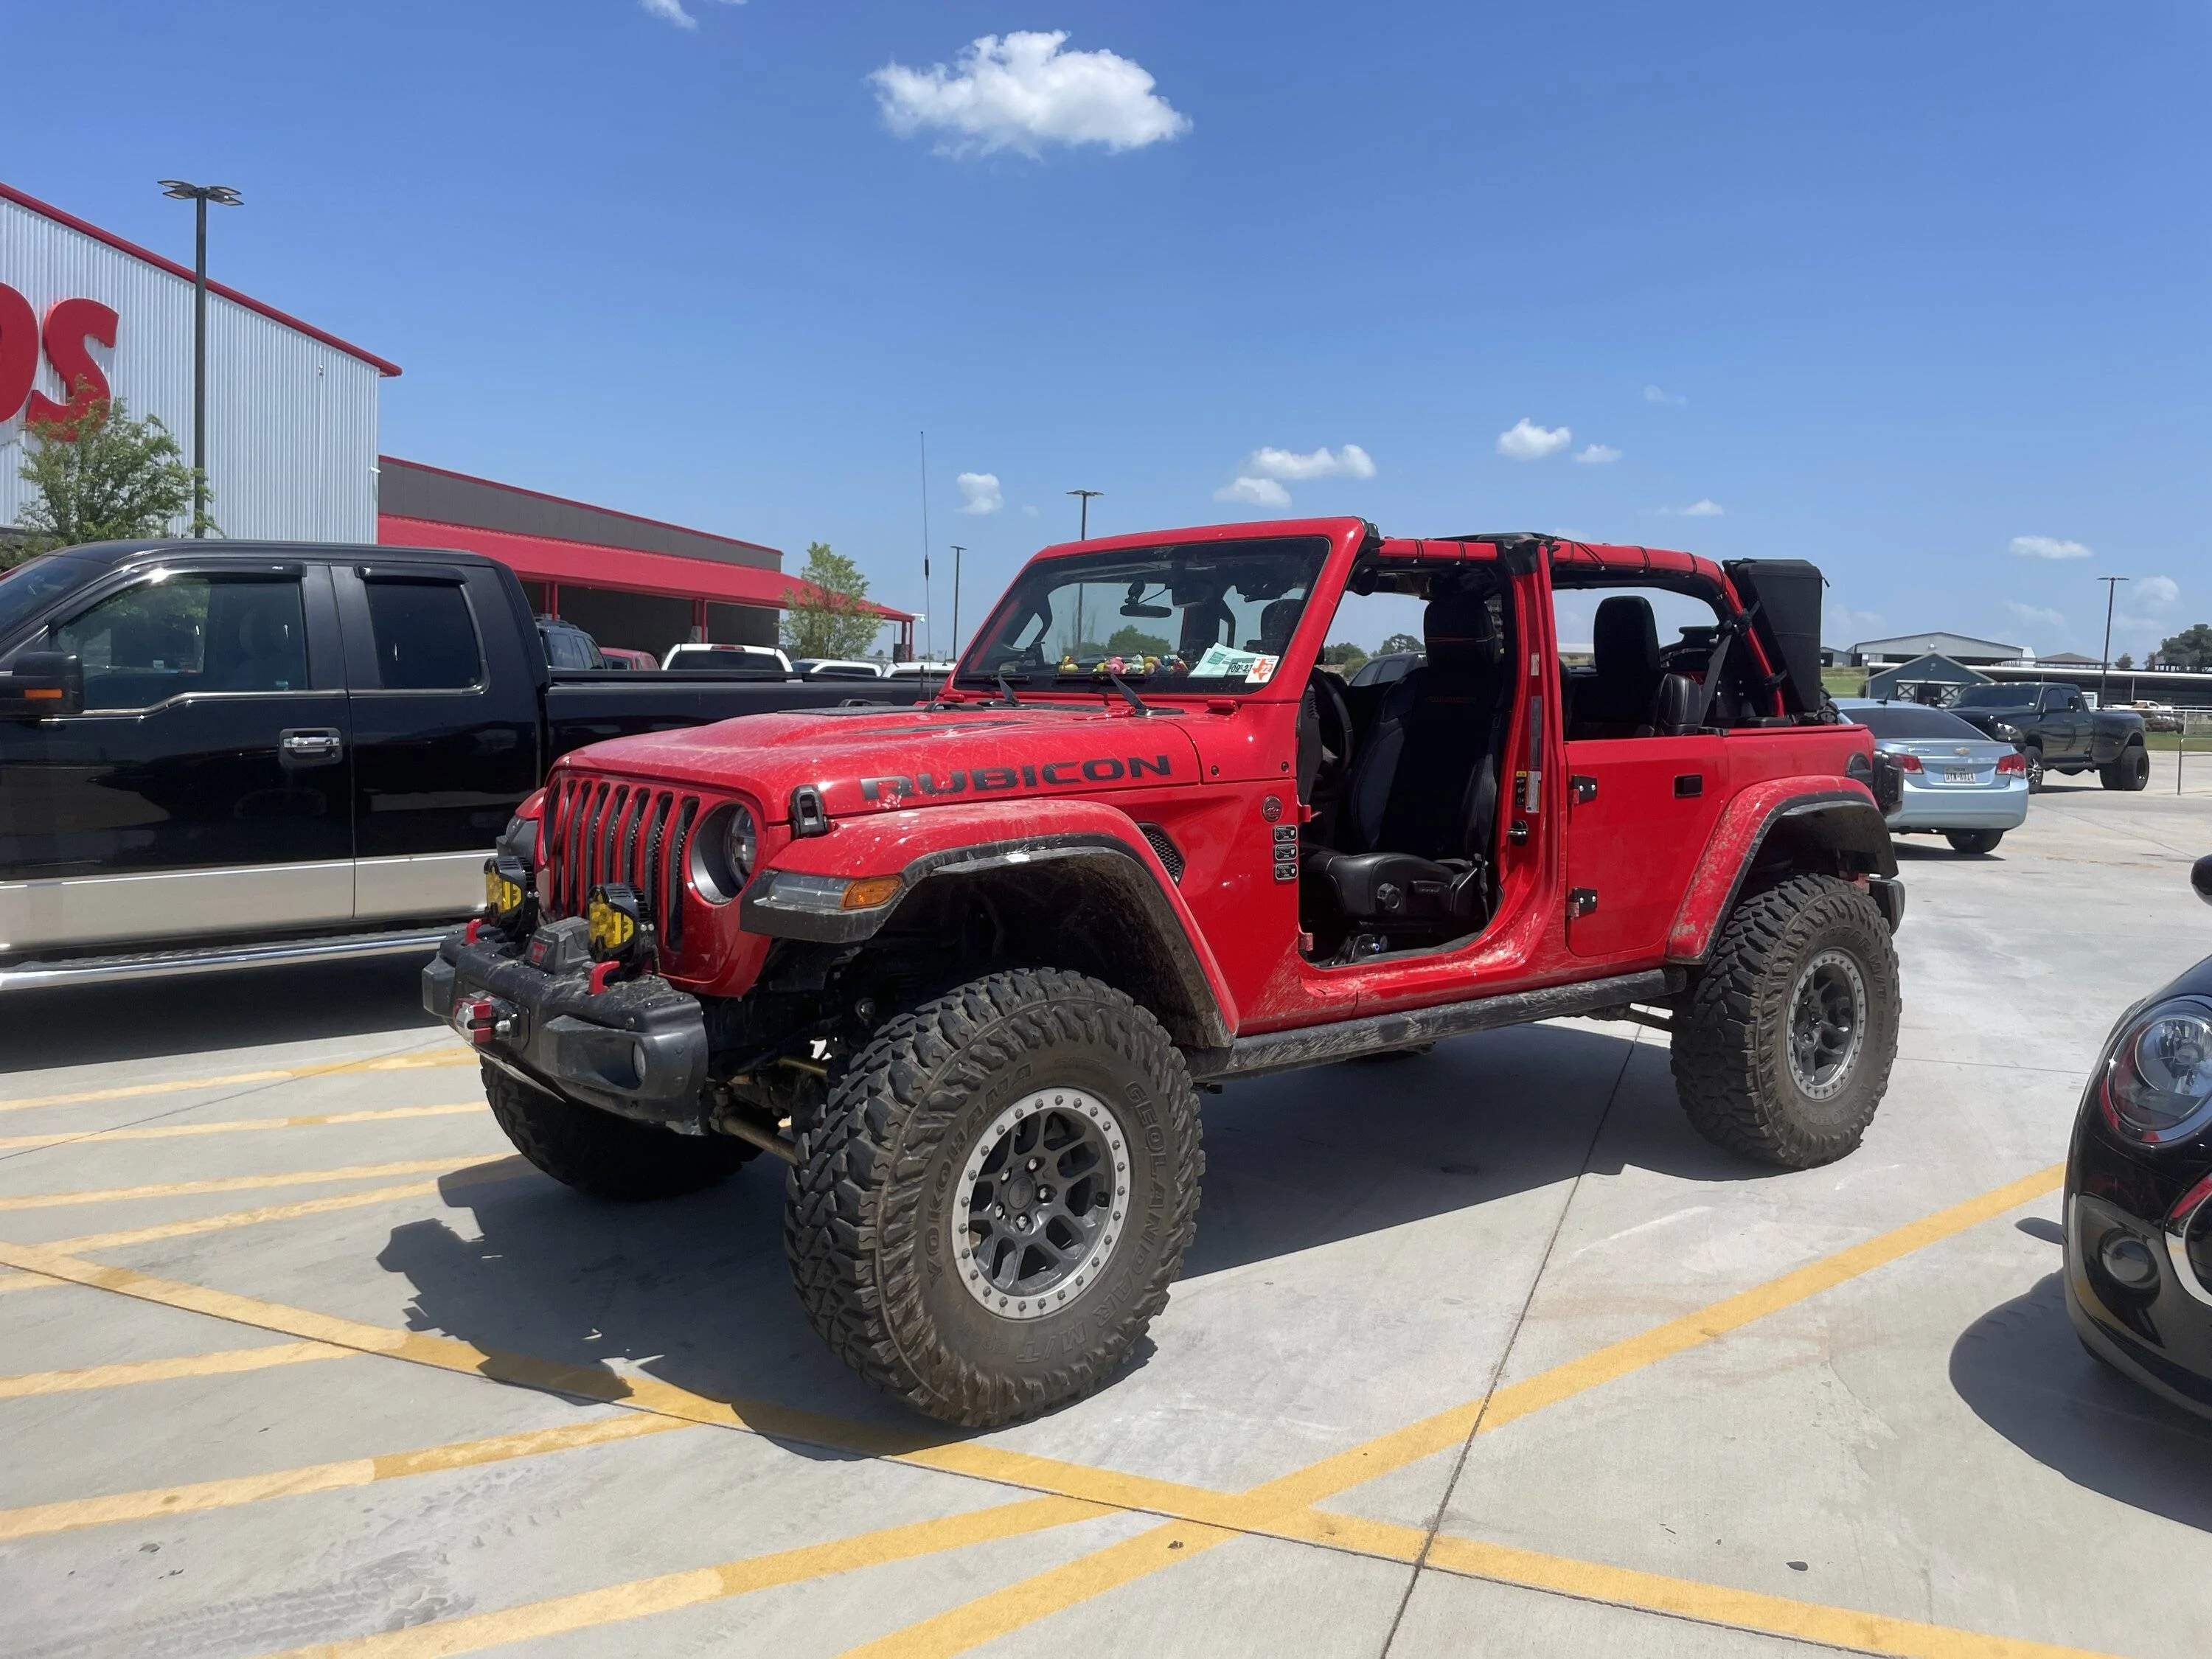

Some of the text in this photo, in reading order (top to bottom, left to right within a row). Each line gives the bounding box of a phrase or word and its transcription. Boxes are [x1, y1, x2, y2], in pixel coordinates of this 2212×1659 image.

[859, 754, 1171, 801] RUBICON
[925, 1063, 1032, 1288] YOKOHAMA
[1093, 1081, 1166, 1326] GEOLANDAR
[1015, 1321, 1088, 1363] M/T
